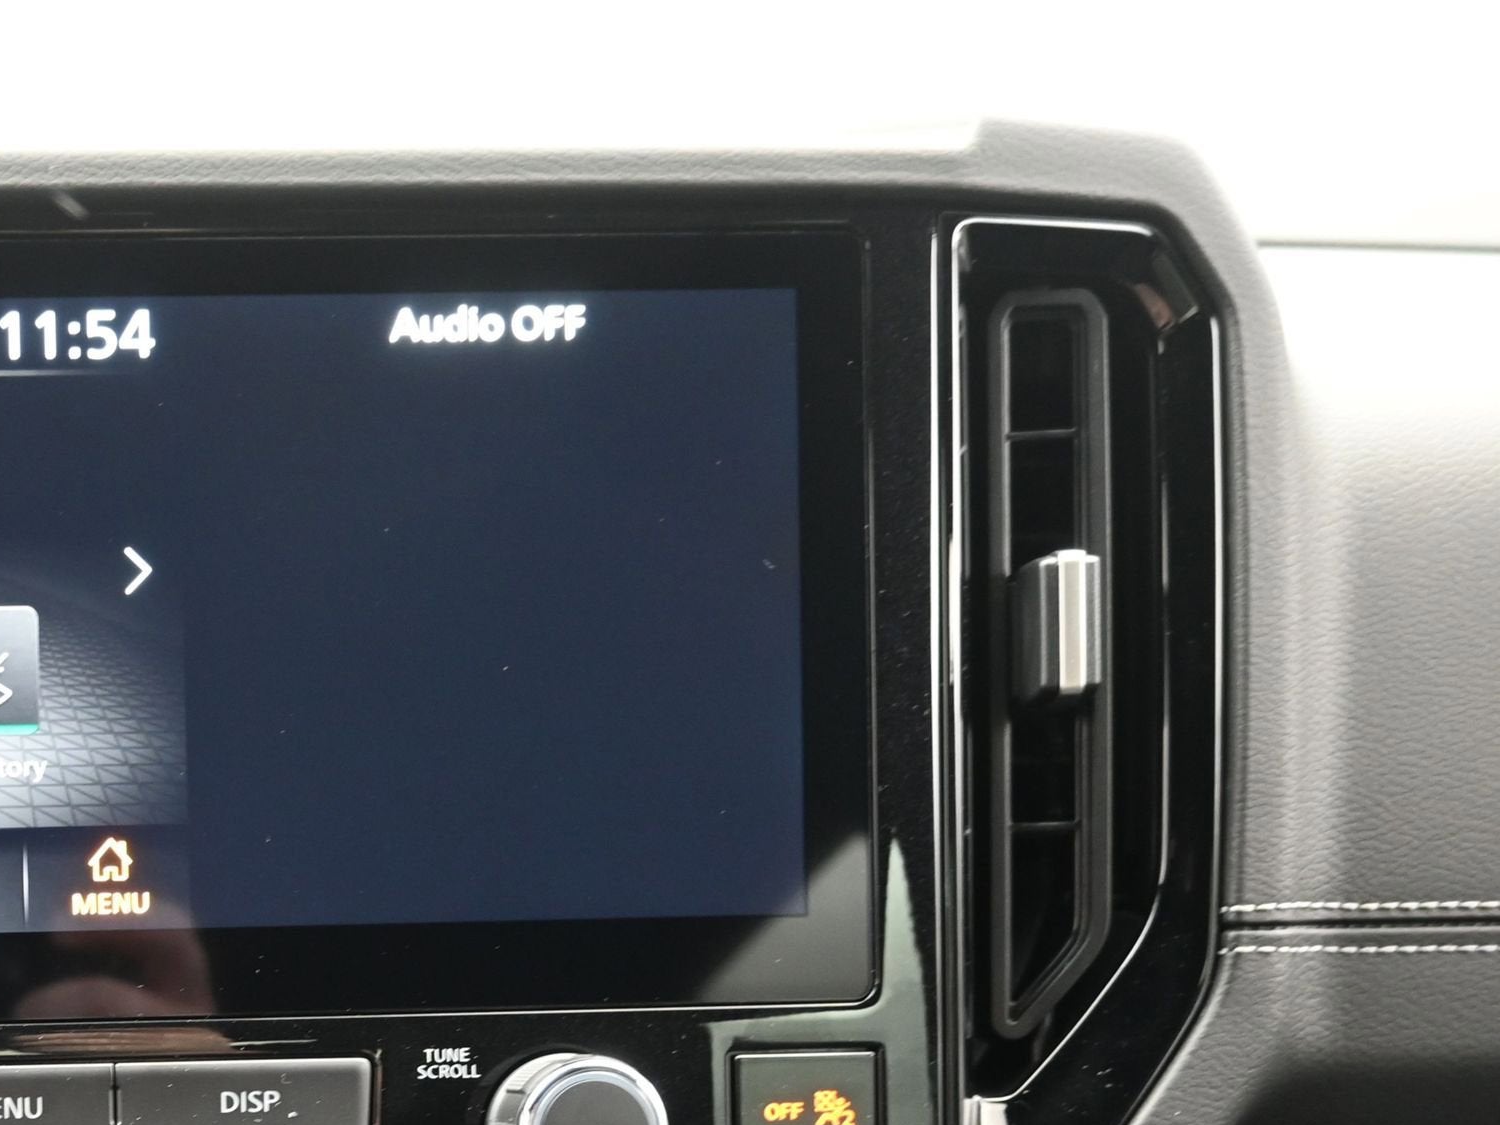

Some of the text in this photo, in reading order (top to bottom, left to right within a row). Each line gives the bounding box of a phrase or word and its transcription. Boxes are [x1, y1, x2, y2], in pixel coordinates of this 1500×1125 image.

[389, 303, 587, 344] Audio OFF
[71, 891, 152, 916] MENU
[423, 1047, 472, 1063] TUNE
[417, 1062, 481, 1080] SCROLL
[219, 1090, 280, 1114] DISP
[763, 1101, 805, 1123] OFF
